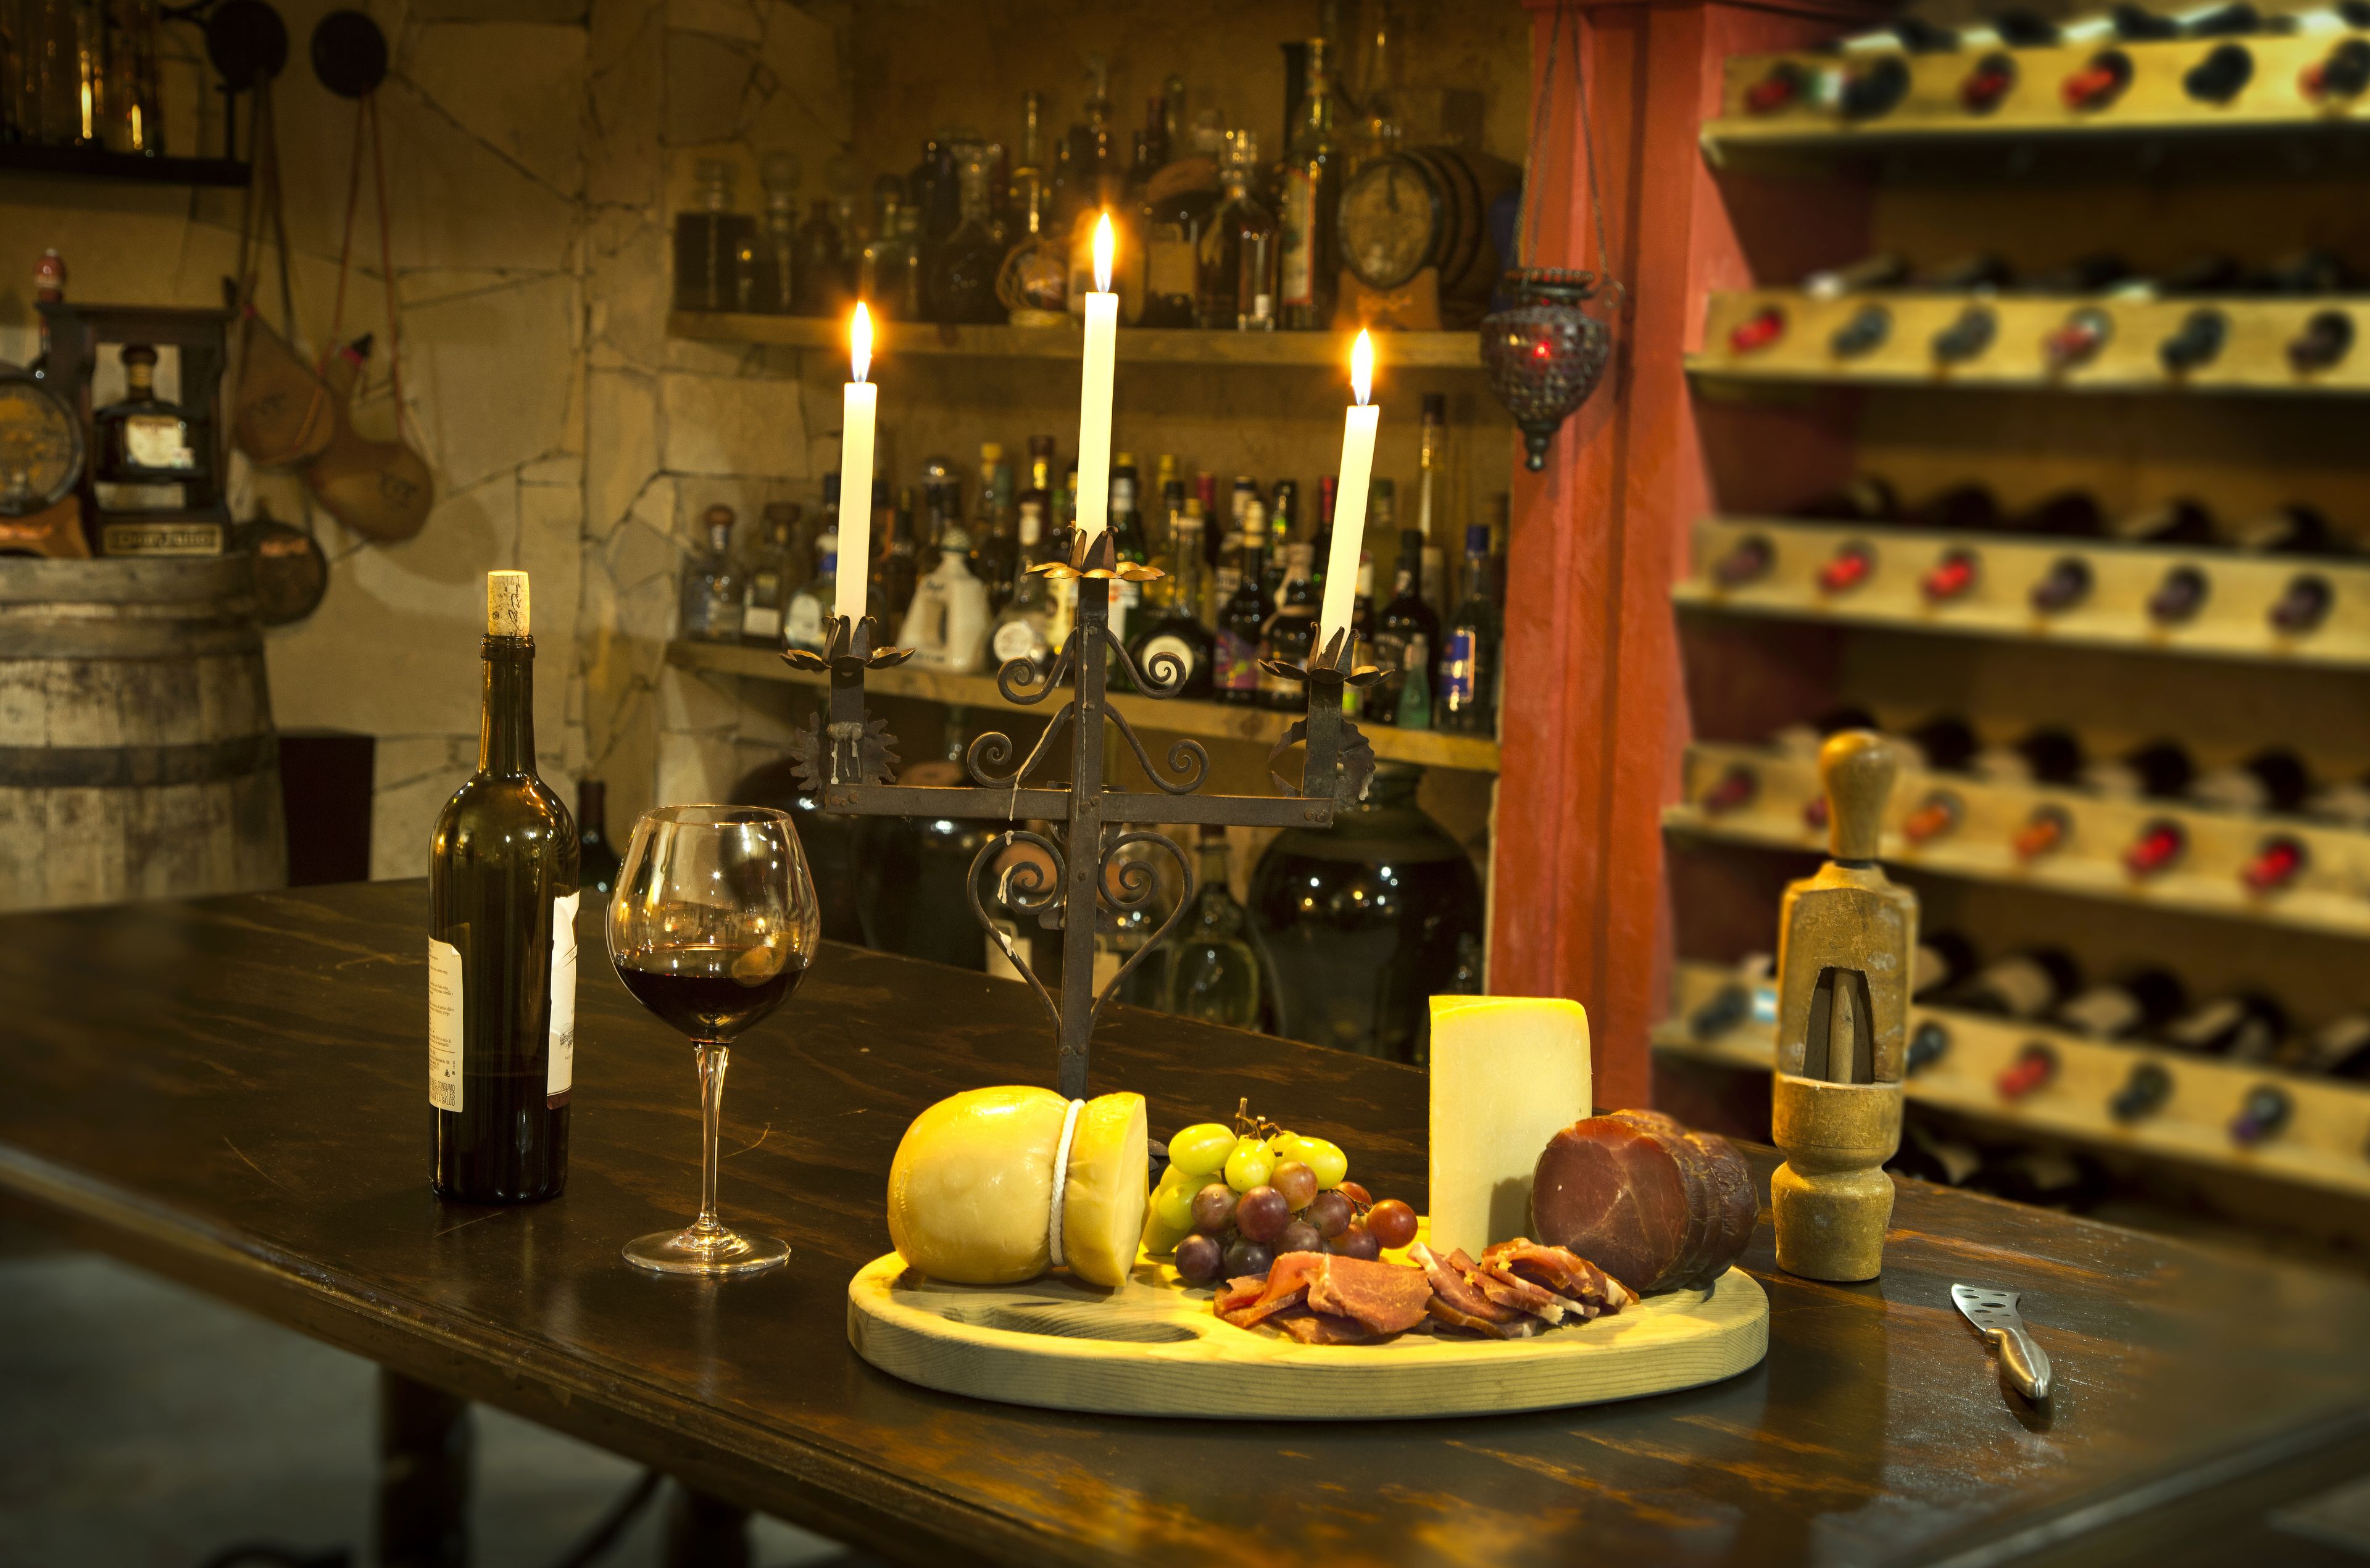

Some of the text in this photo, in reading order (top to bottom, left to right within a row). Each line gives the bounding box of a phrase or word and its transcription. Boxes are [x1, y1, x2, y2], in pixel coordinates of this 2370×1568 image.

[438, 1081, 455, 1092] CONSUMO
[449, 1091, 455, 1099] ES
[442, 1097, 455, 1106] SALUD
